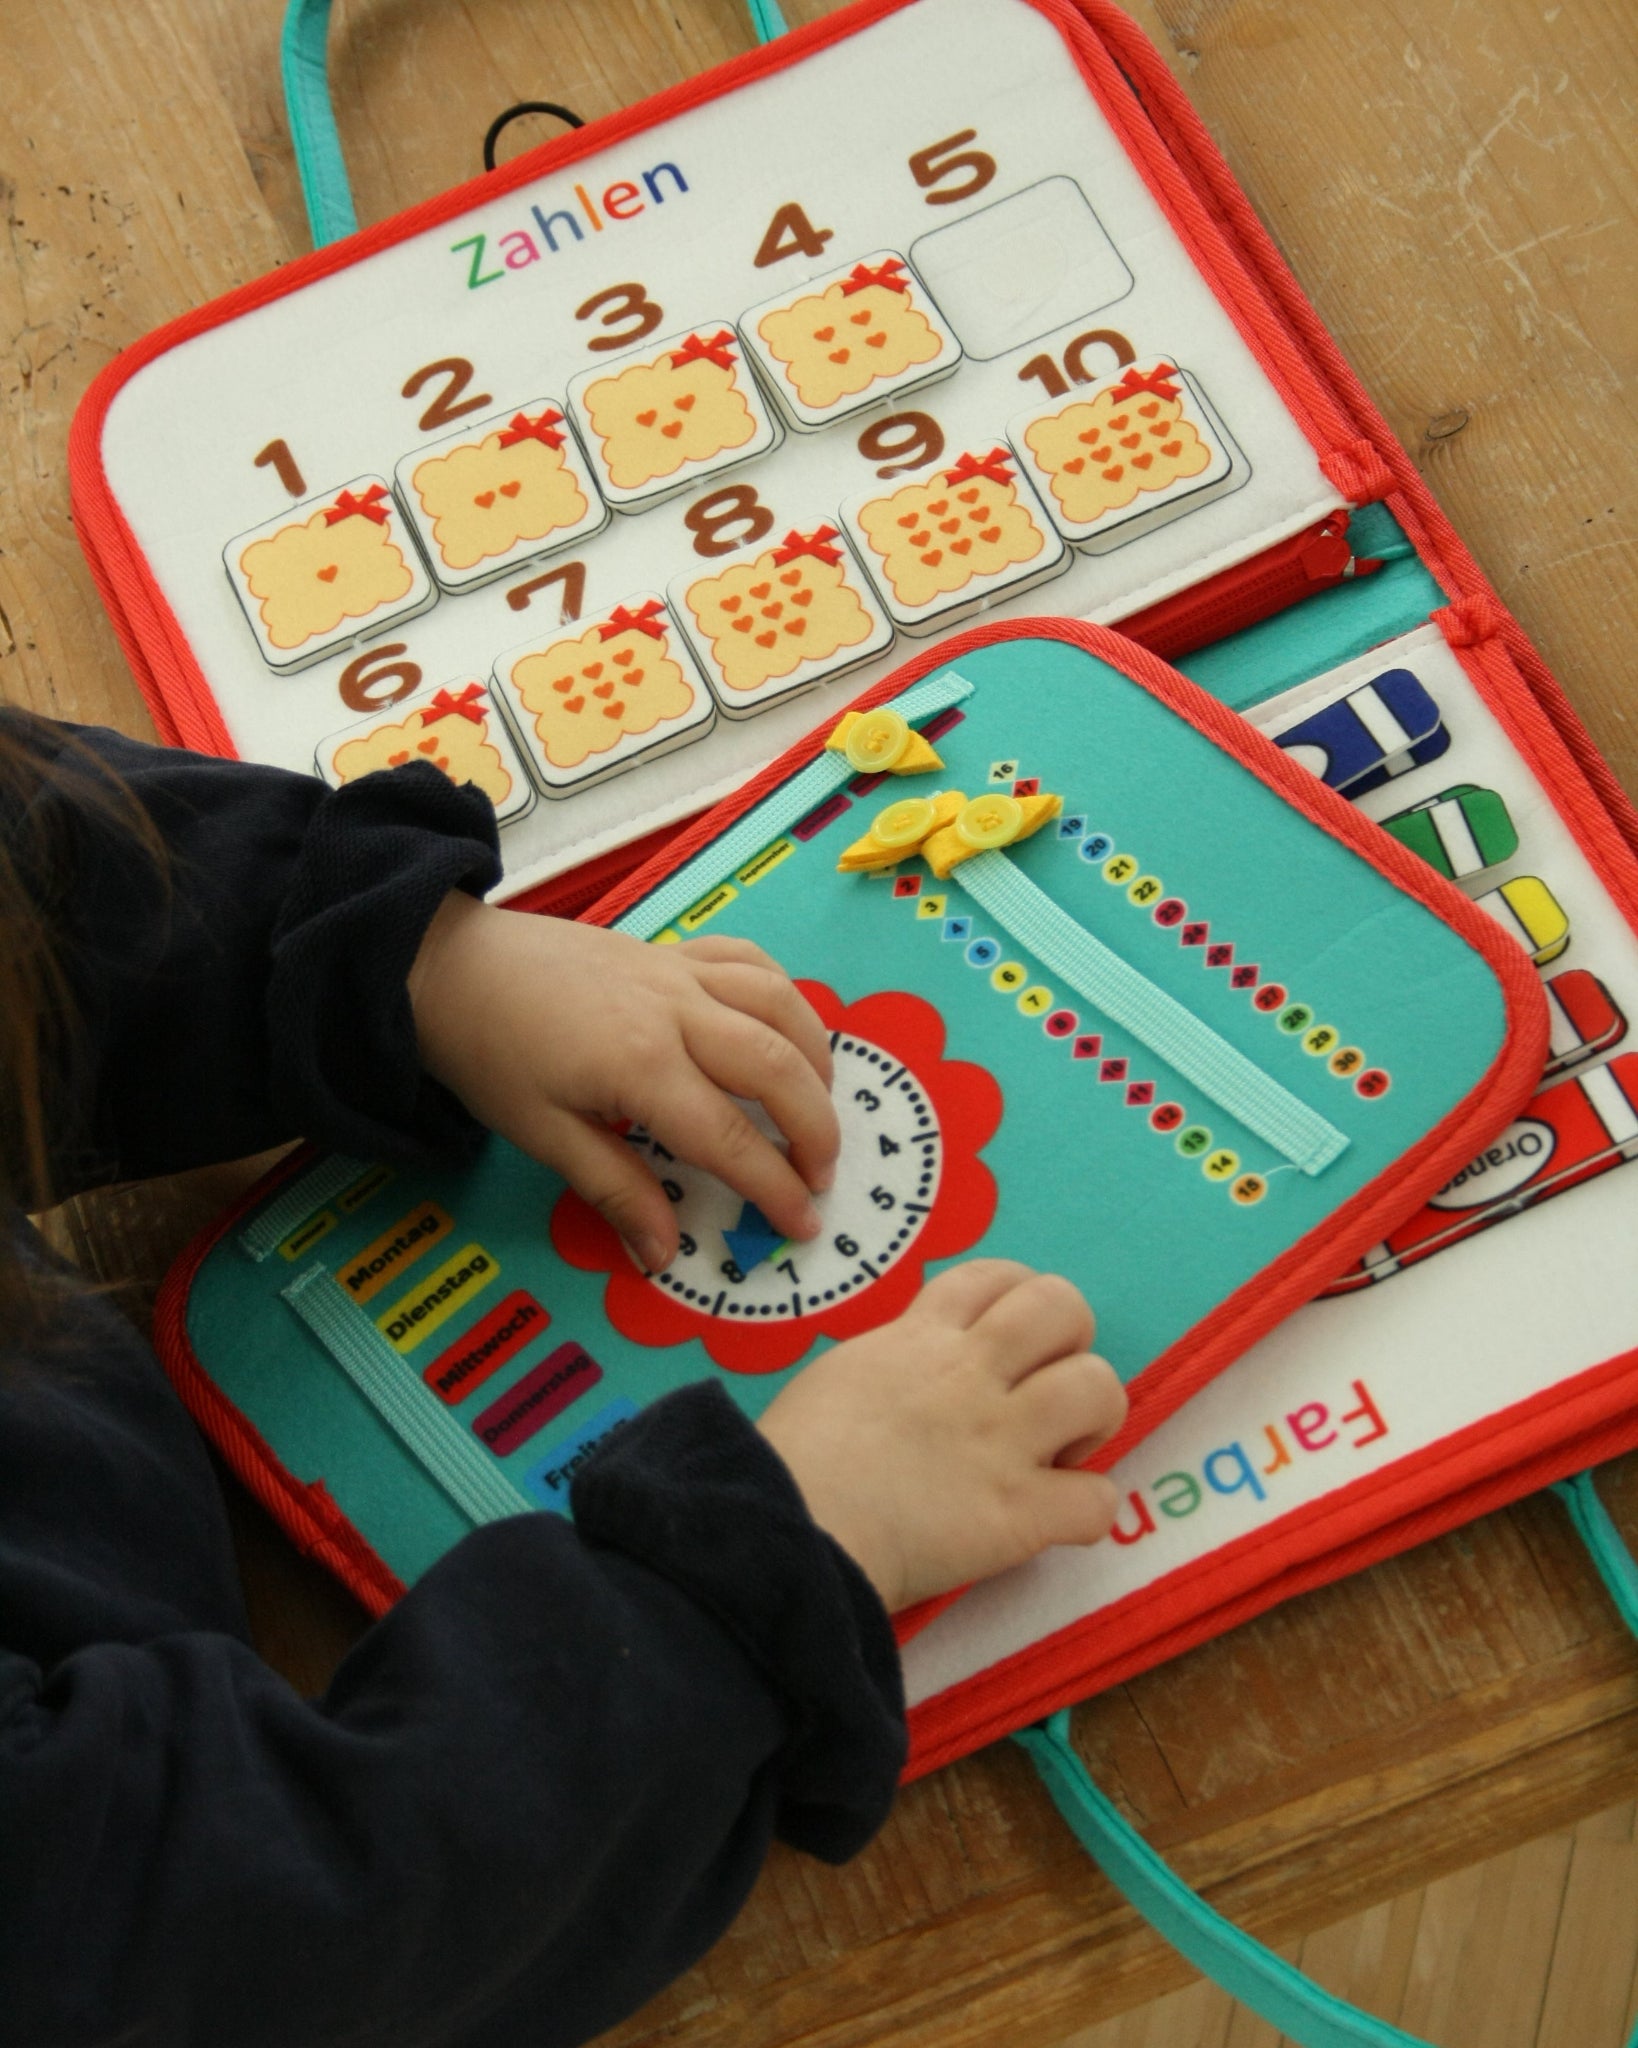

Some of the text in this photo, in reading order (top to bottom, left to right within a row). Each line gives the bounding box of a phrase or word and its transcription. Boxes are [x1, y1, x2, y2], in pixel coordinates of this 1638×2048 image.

[451, 161, 689, 290] Zahlen
[254, 129, 997, 498] 1 2 3 4 5
[339, 329, 1137, 712] 6 7 8 9 10
[993, 763, 1014, 779] 16
[739, 843, 790, 883] September
[689, 891, 728, 923] August
[1060, 818, 1082, 836] 19
[1085, 838, 1107, 858] 20
[1109, 859, 1131, 880] 21
[1134, 880, 1157, 902] 22
[1308, 1029, 1332, 1050] 29
[1334, 1052, 1357, 1072] 30
[1361, 1074, 1384, 1093] 31
[901, 879, 915, 893] 2
[925, 901, 939, 914] 3
[951, 922, 965, 935] 4
[976, 946, 990, 959] 5
[1002, 971, 1016, 983] 6
[1027, 994, 1041, 1007] 7
[1184, 1131, 1207, 1150] 13
[1210, 1155, 1233, 1173] 14
[854, 1088, 880, 1112] 3
[879, 1134, 900, 1157] 4
[870, 1186, 896, 1211] 5
[346, 1212, 441, 1292] Montag
[679, 1232, 698, 1257] 9
[720, 1260, 746, 1284] 8
[776, 1259, 801, 1284] 7
[834, 1234, 859, 1257] 6
[385, 1253, 490, 1343] Dienstag
[436, 1300, 538, 1394] Mittwoch
[482, 1352, 593, 1445] Donnerstag
[543, 1417, 628, 1491] Freit
[1109, 1378, 1389, 1546] Farben
